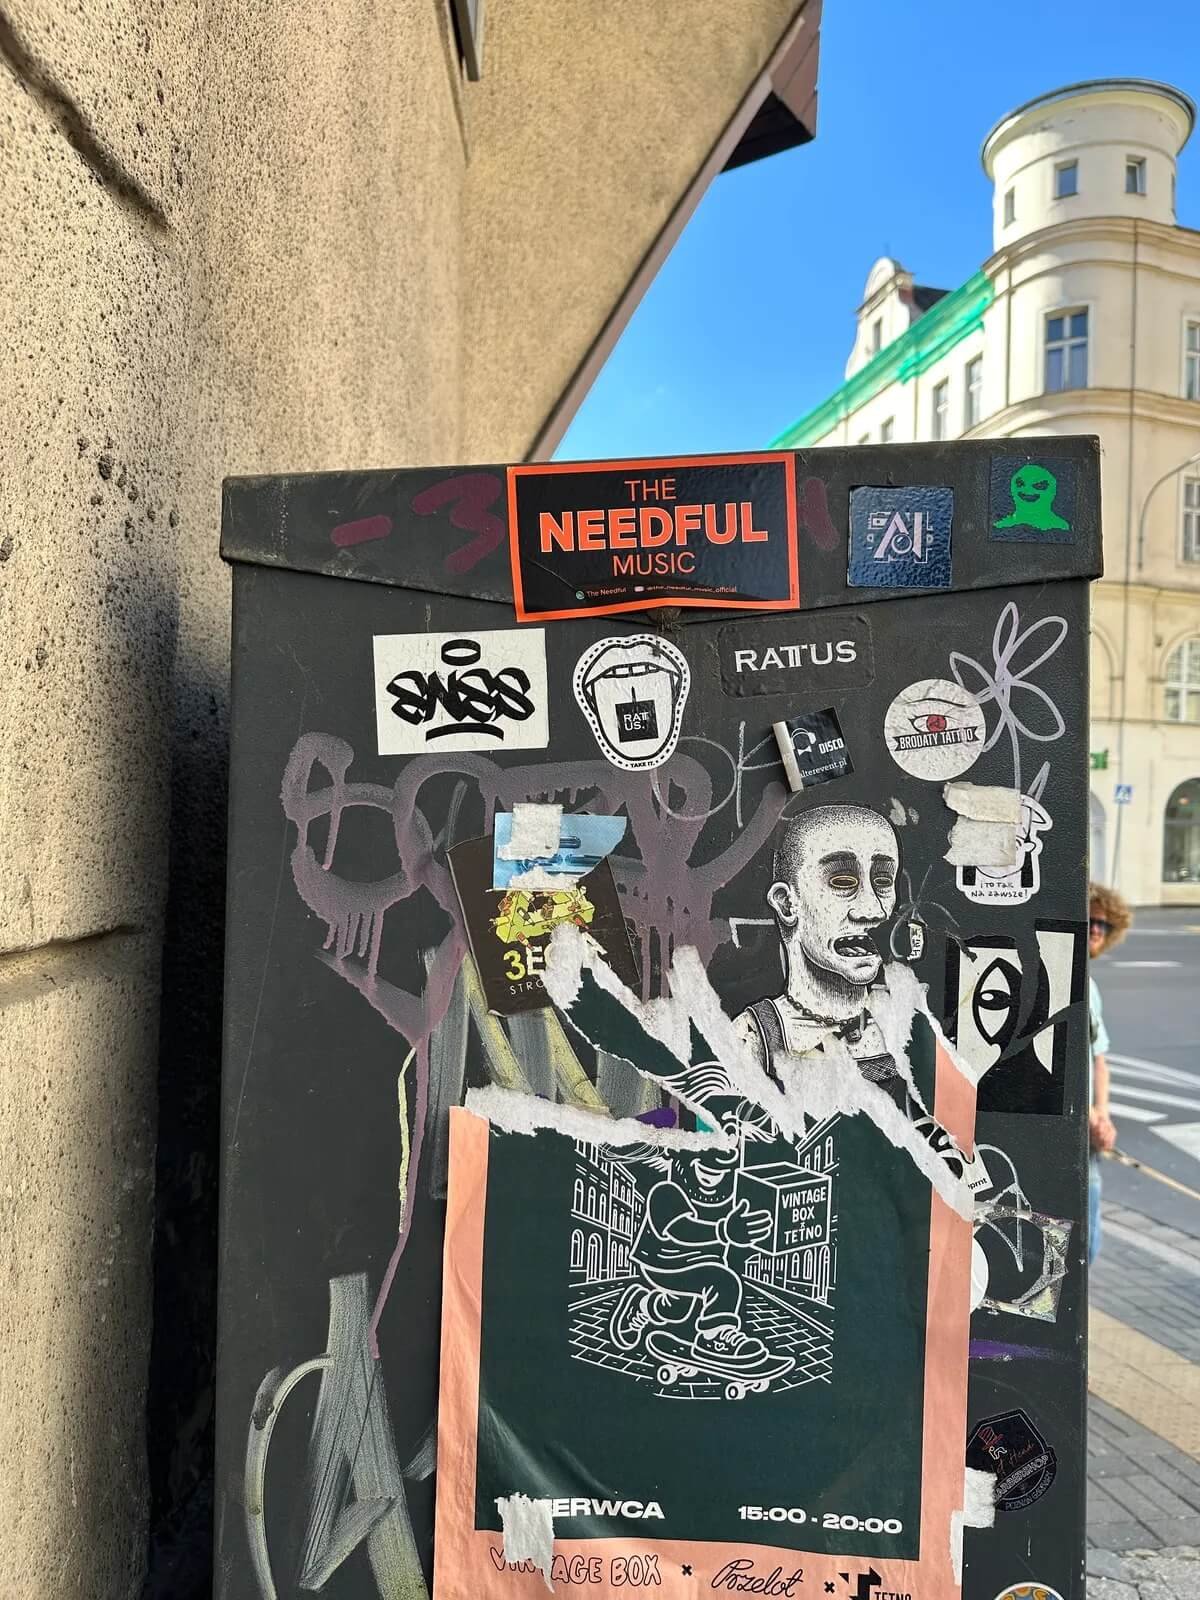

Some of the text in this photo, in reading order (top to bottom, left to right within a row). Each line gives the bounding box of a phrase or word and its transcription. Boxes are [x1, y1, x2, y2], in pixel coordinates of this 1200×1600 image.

[624, 478, 677, 502] THE
[539, 502, 769, 552] NEEDFUL
[612, 551, 696, 577] MUSIC
[587, 587, 627, 598] The Needful
[818, 737, 844, 754] DISCO
[899, 733, 938, 749] BRODATY
[781, 1186, 827, 1209] VINTAGE
[791, 1206, 815, 1223] BOX
[784, 1224, 823, 1245] TETNO
[738, 1506, 807, 1524] 15:00
[822, 1513, 903, 1534] 20:00
[610, 1554, 662, 1587] BOX
[711, 1559, 804, 1598] Przelot
